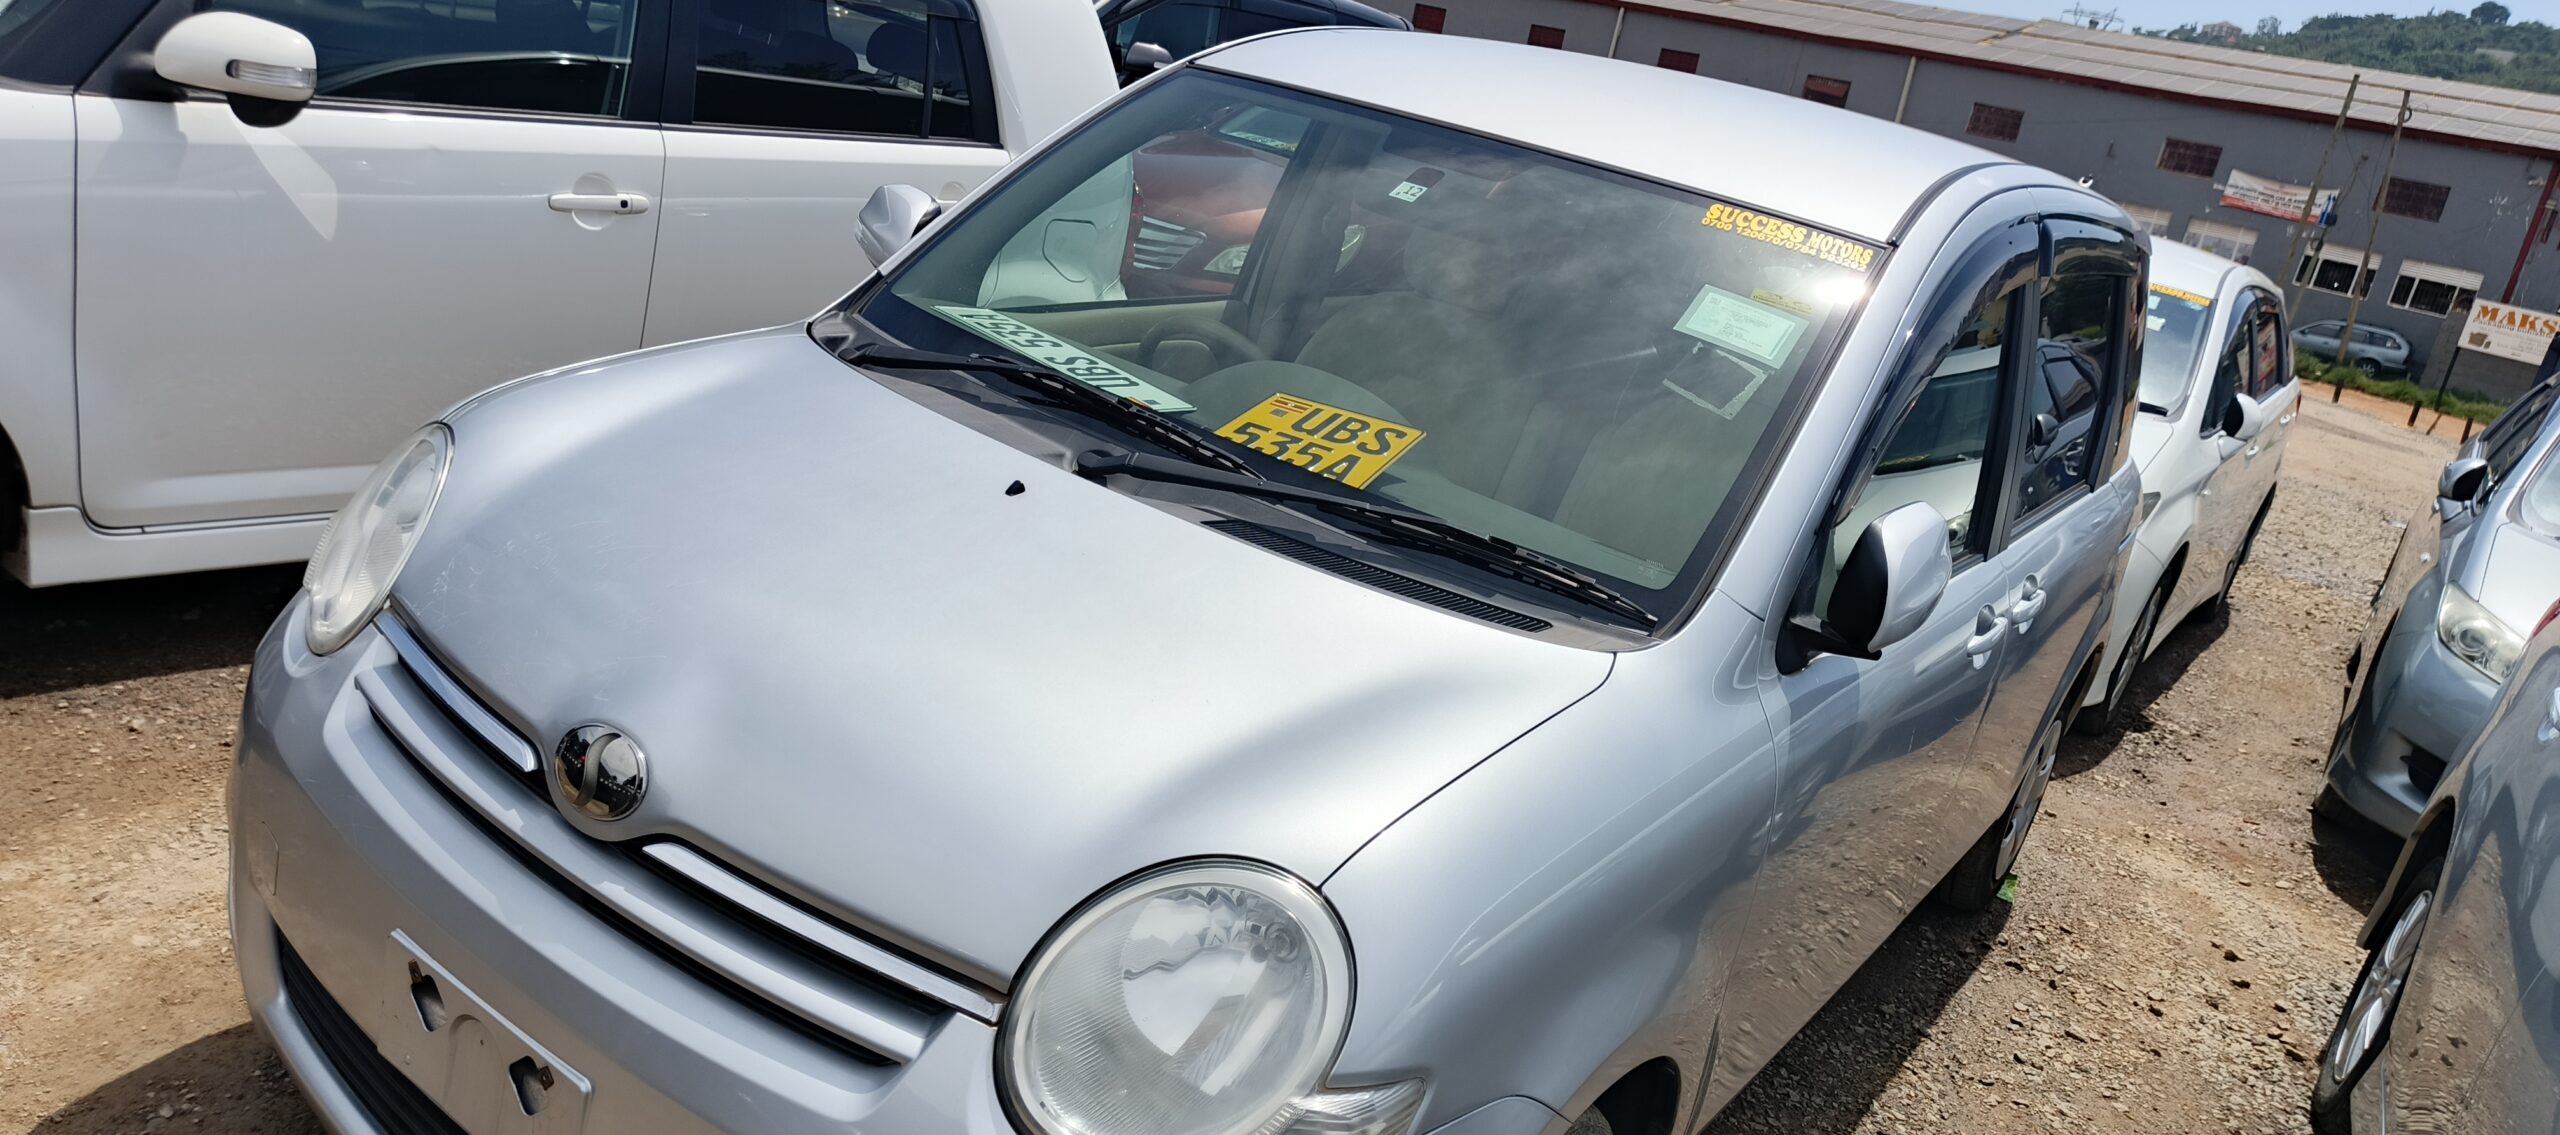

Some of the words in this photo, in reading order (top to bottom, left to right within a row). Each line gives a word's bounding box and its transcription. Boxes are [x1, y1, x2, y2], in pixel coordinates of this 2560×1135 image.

[1701, 216, 1733, 232] 0700
[1706, 203, 1807, 243] SUCCESS
[1808, 230, 1874, 265] MOTORS
[958, 313, 1063, 349] 535A
[2474, 305, 2557, 334] MAKS
[1044, 355, 1141, 389] UBS
[1291, 407, 1409, 456] UBS
[1224, 421, 1362, 482] 535A
